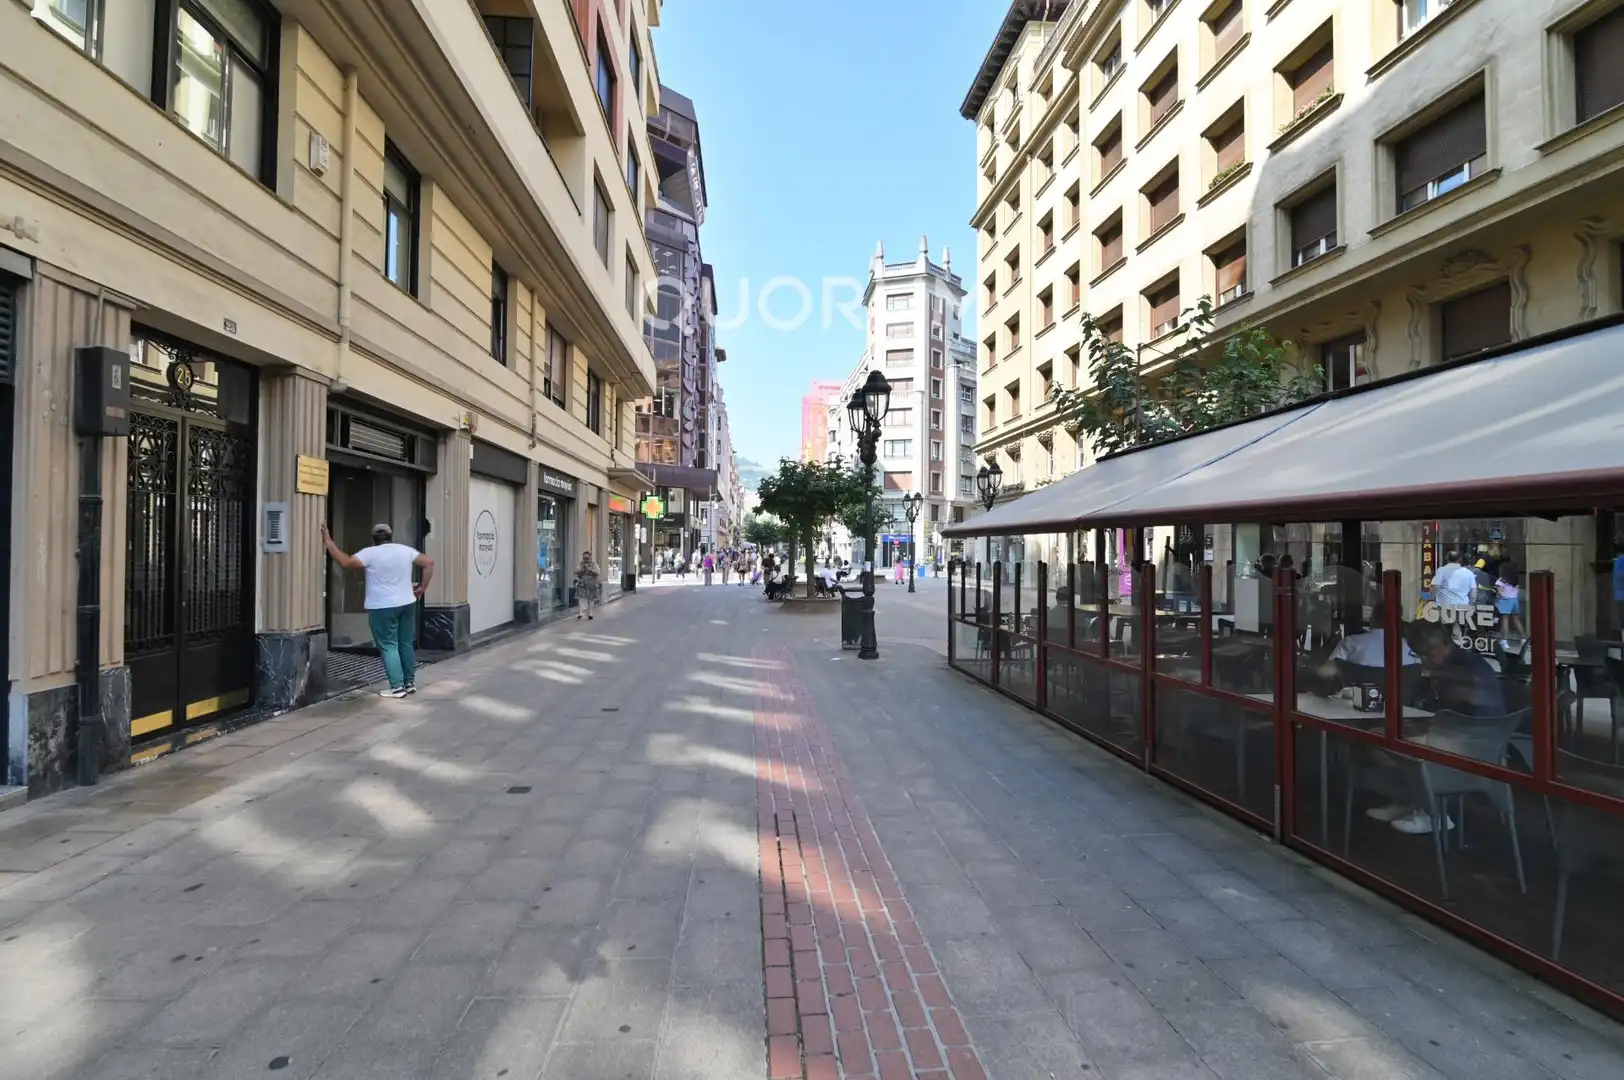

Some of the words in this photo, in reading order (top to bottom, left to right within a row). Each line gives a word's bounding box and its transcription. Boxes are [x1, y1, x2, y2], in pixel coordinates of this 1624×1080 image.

[177, 367, 191, 386] 25
[1423, 601, 1495, 630] GURE
[1460, 631, 1497, 653] bar
